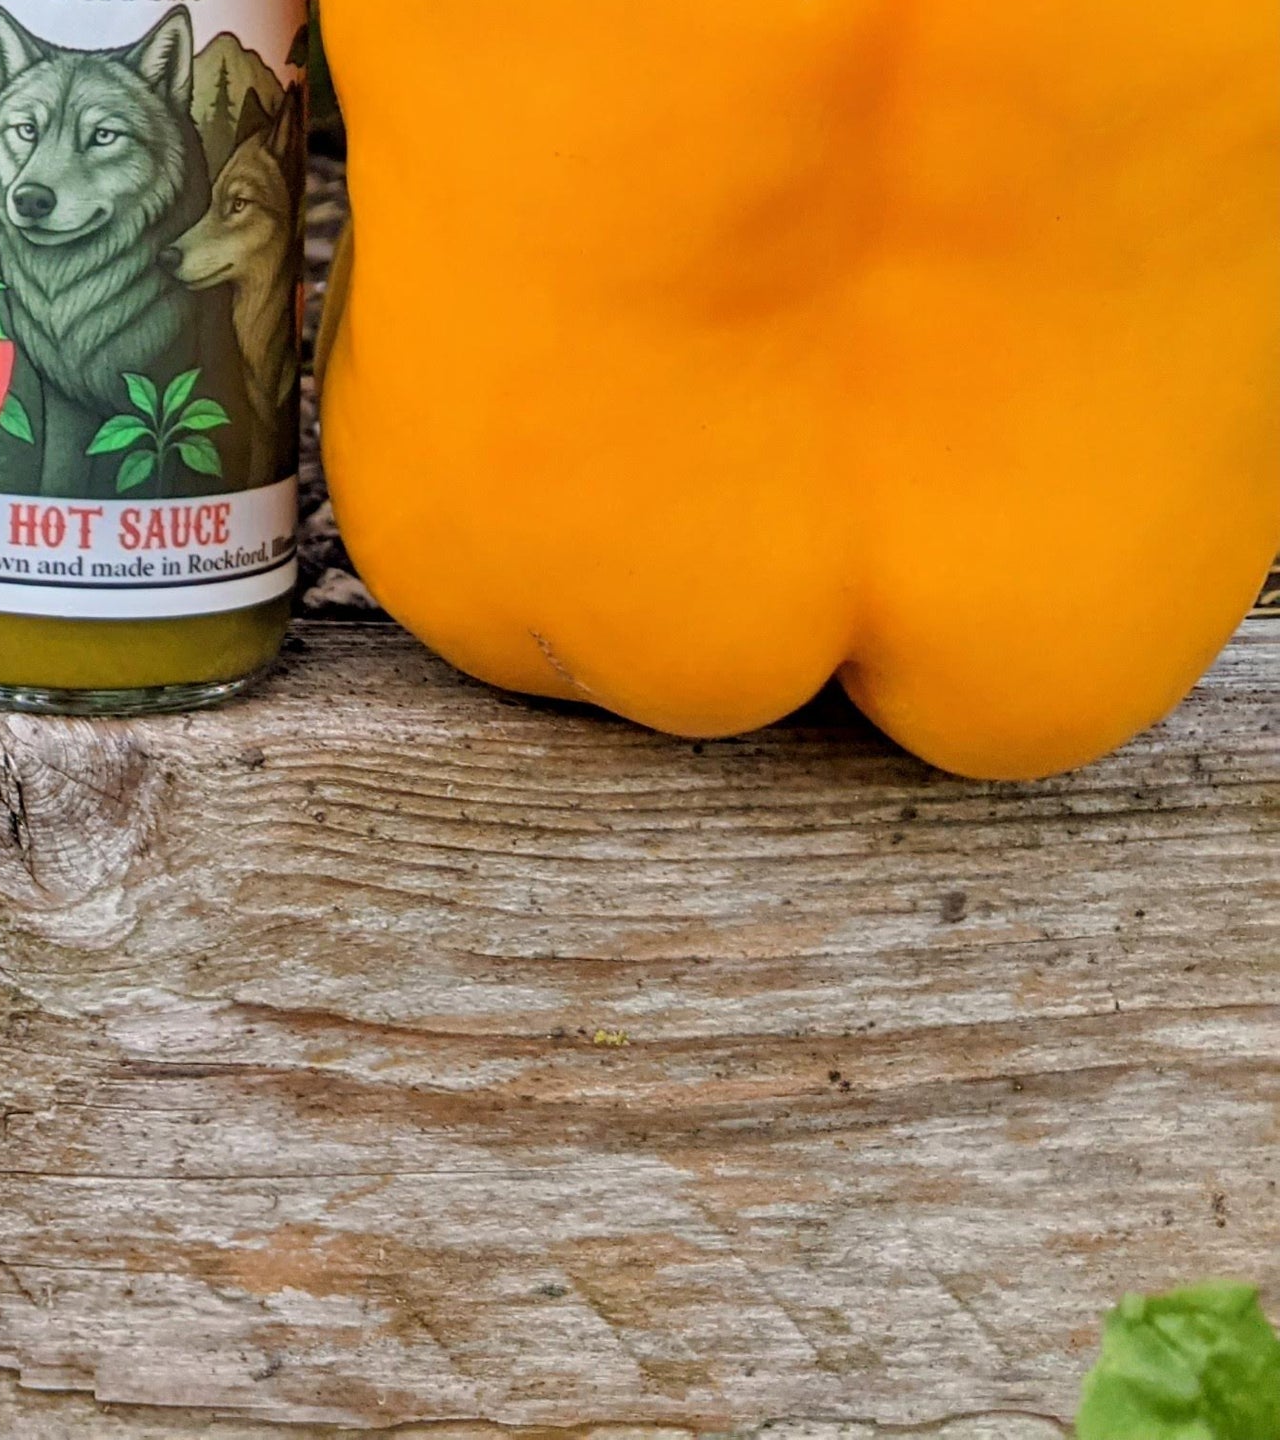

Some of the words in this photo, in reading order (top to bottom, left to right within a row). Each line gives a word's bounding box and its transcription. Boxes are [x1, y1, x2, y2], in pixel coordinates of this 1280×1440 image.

[9, 503, 103, 550] HOT
[118, 502, 230, 550] SAUCE
[37, 555, 83, 578] and
[91, 556, 154, 578] made
[162, 552, 182, 576] in
